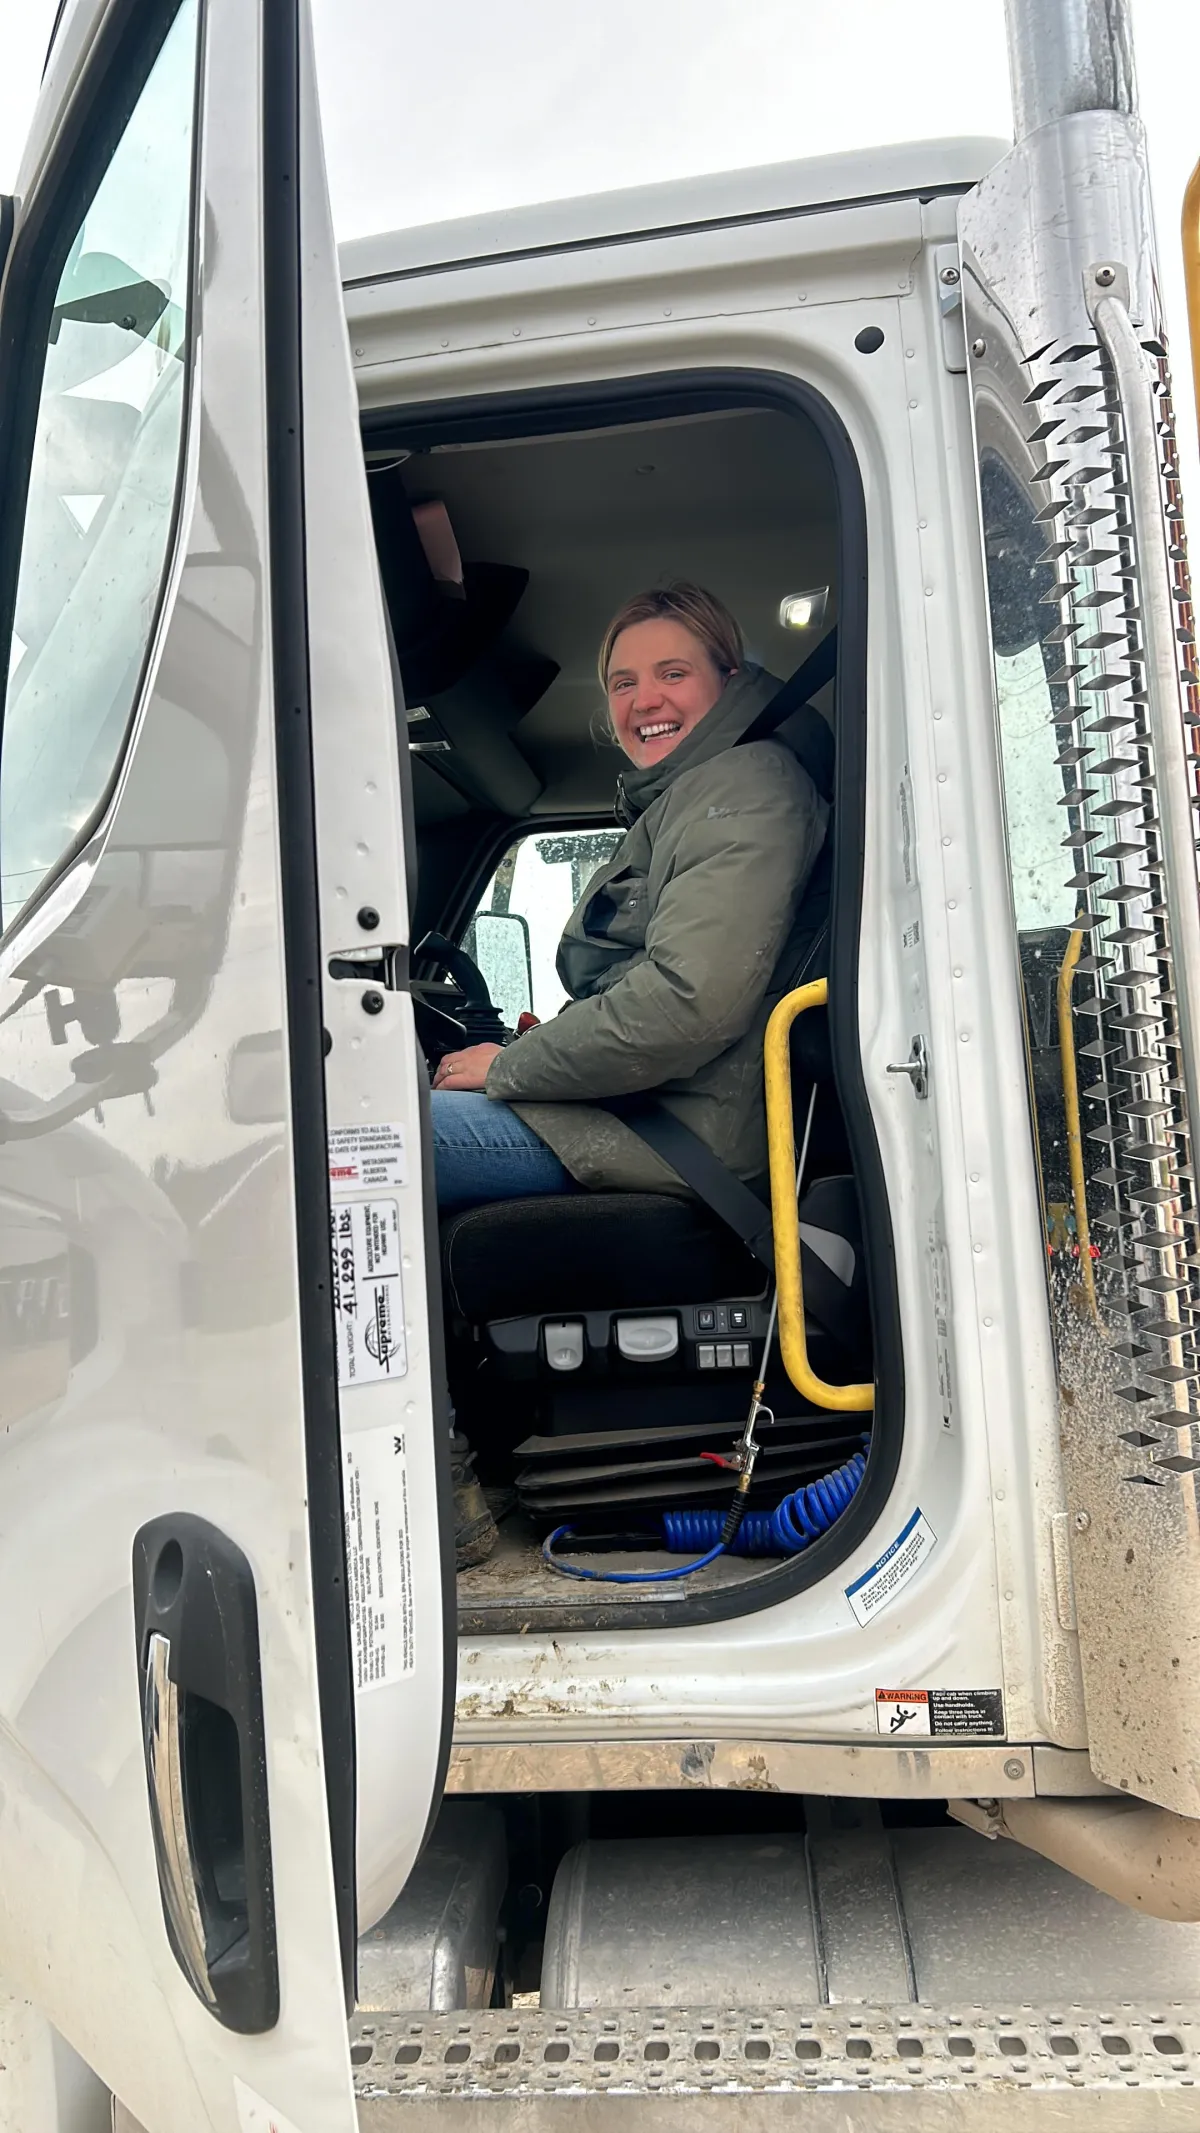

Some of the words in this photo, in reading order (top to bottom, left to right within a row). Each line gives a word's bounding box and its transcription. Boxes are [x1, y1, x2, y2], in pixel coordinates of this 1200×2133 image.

[336, 1136, 358, 1144] SAFETY
[362, 1167, 387, 1175] ALBERTA
[363, 1176, 388, 1184] CANADA
[375, 1294, 392, 1372] Supreme
[348, 1357, 356, 1378] TOTAL
[860, 1591, 867, 1599] To
[868, 1578, 882, 1593] avoid
[883, 1552, 906, 1578] excessive
[905, 1532, 923, 1552] battery
[875, 1540, 900, 1570] NOTICE
[864, 1591, 882, 1607] switch
[899, 1558, 911, 1573] when
[912, 1537, 926, 1559] parked
[865, 1603, 874, 1611] for
[875, 1590, 888, 1604] more
[889, 1577, 900, 1590] than
[900, 1567, 909, 1578] one
[886, 1691, 927, 1701] WARNING
